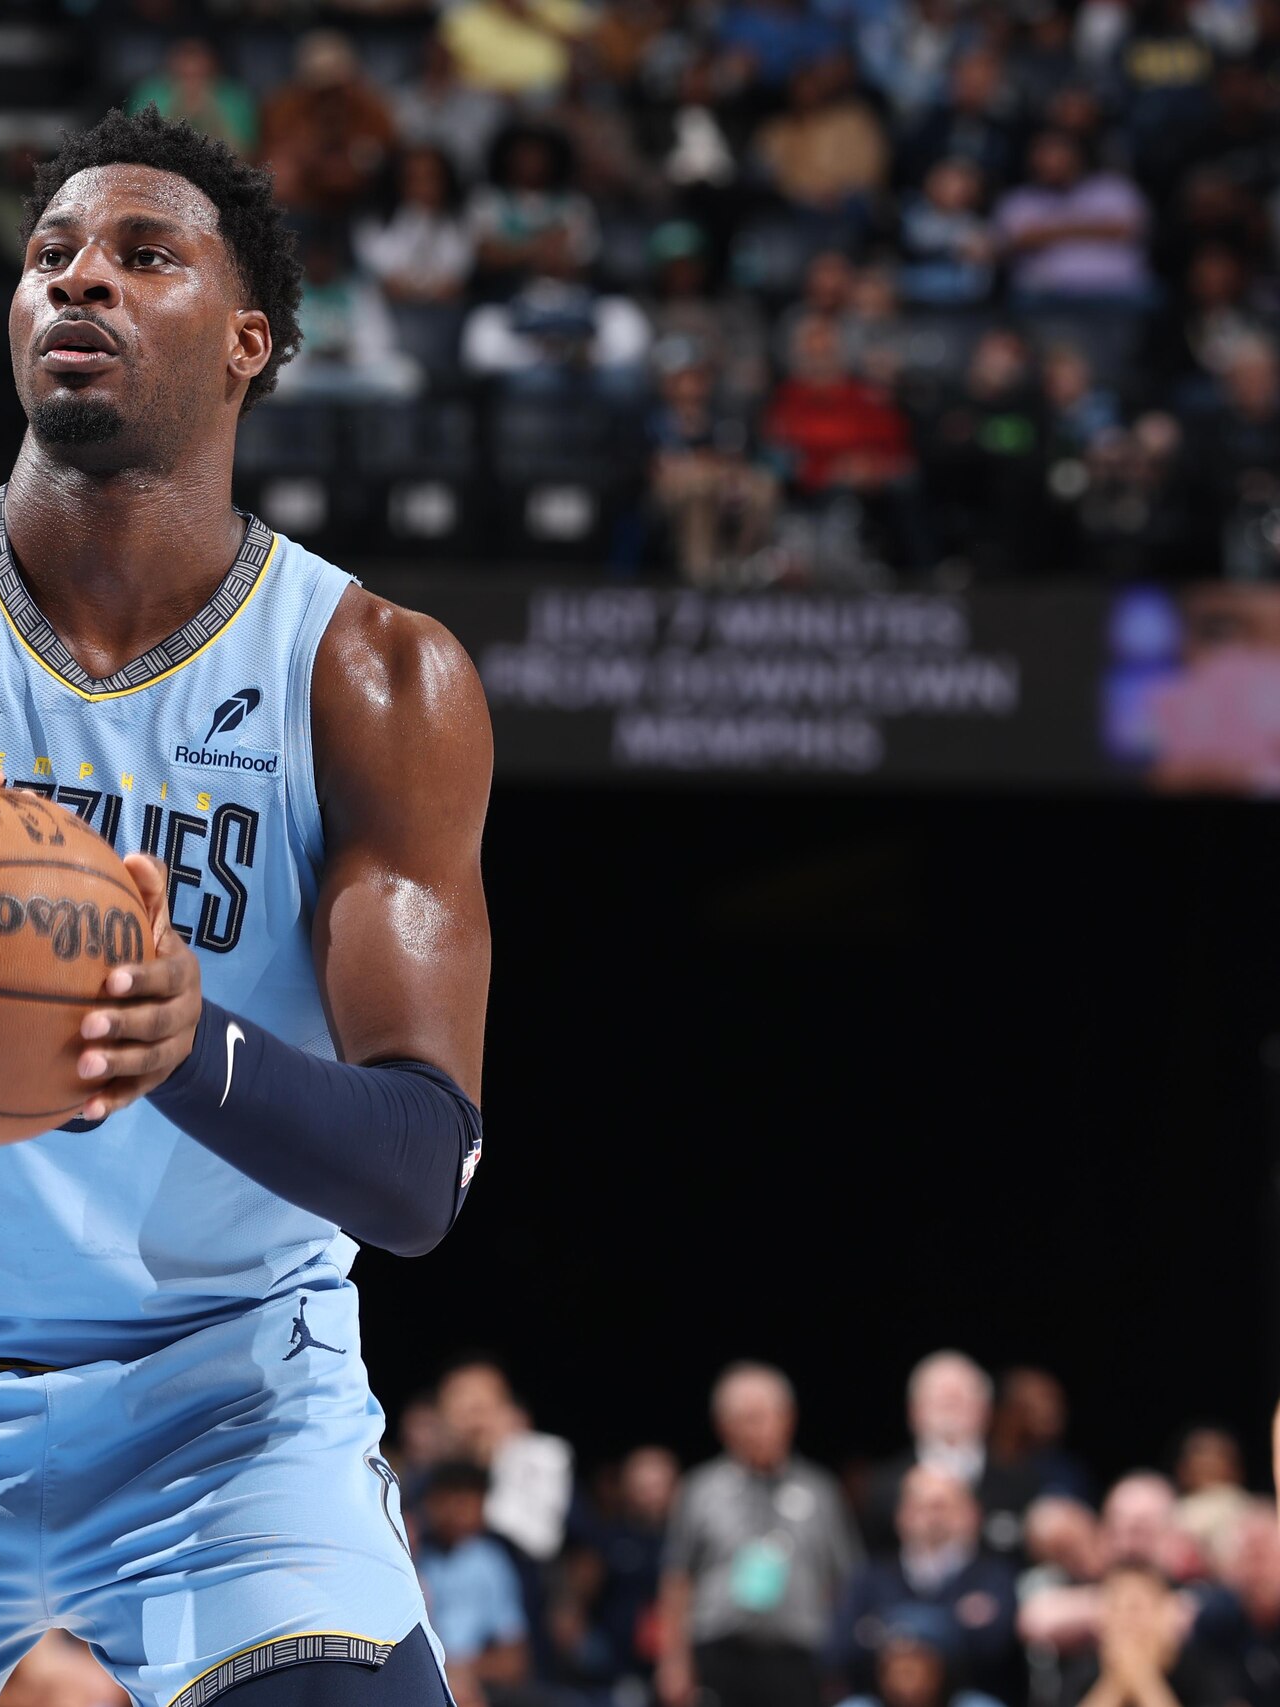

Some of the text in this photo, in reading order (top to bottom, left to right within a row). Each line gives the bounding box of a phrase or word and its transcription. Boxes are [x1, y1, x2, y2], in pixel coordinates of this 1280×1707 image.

[654, 651, 1017, 712] DOWNTOWN
[175, 745, 278, 773] Robinhood
[616, 712, 880, 770] MEMPHIS
